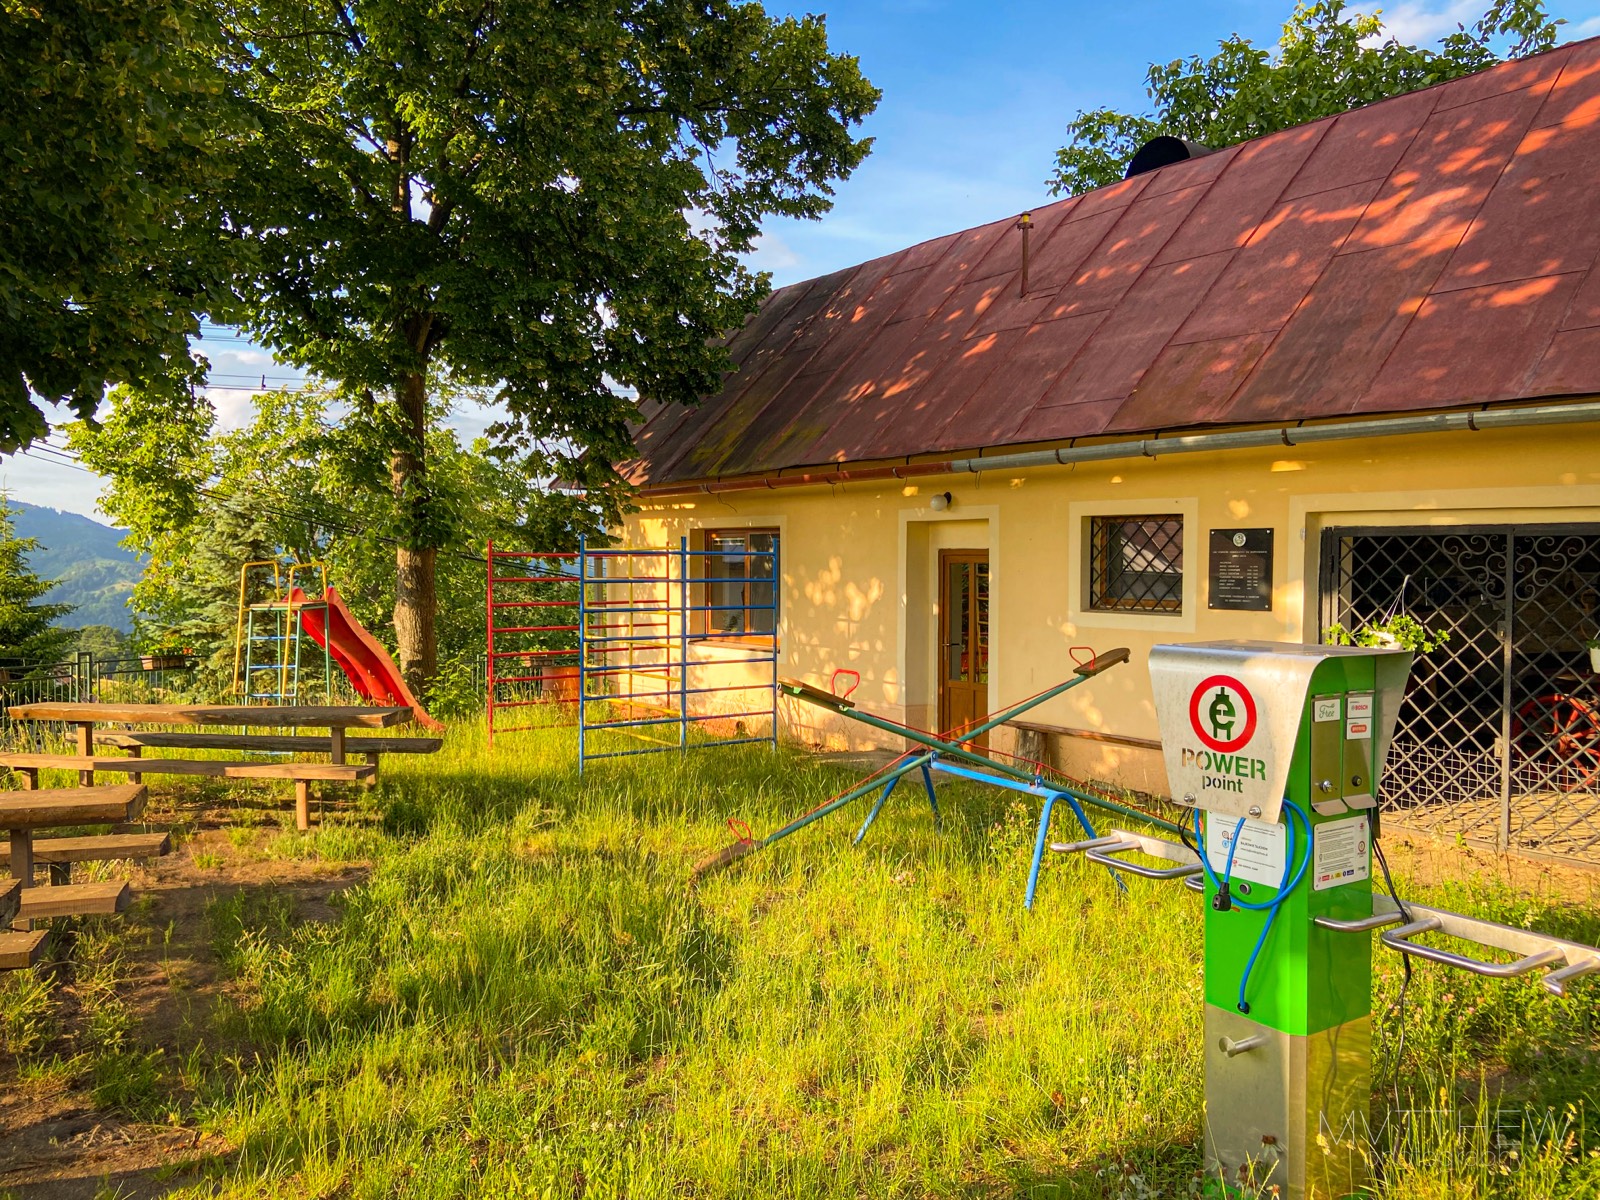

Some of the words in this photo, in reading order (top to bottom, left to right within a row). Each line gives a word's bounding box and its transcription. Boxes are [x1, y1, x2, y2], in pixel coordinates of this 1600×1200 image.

[1319, 703, 1335, 719] Free
[1181, 747, 1266, 781] POWER
[1202, 775, 1243, 793] point
